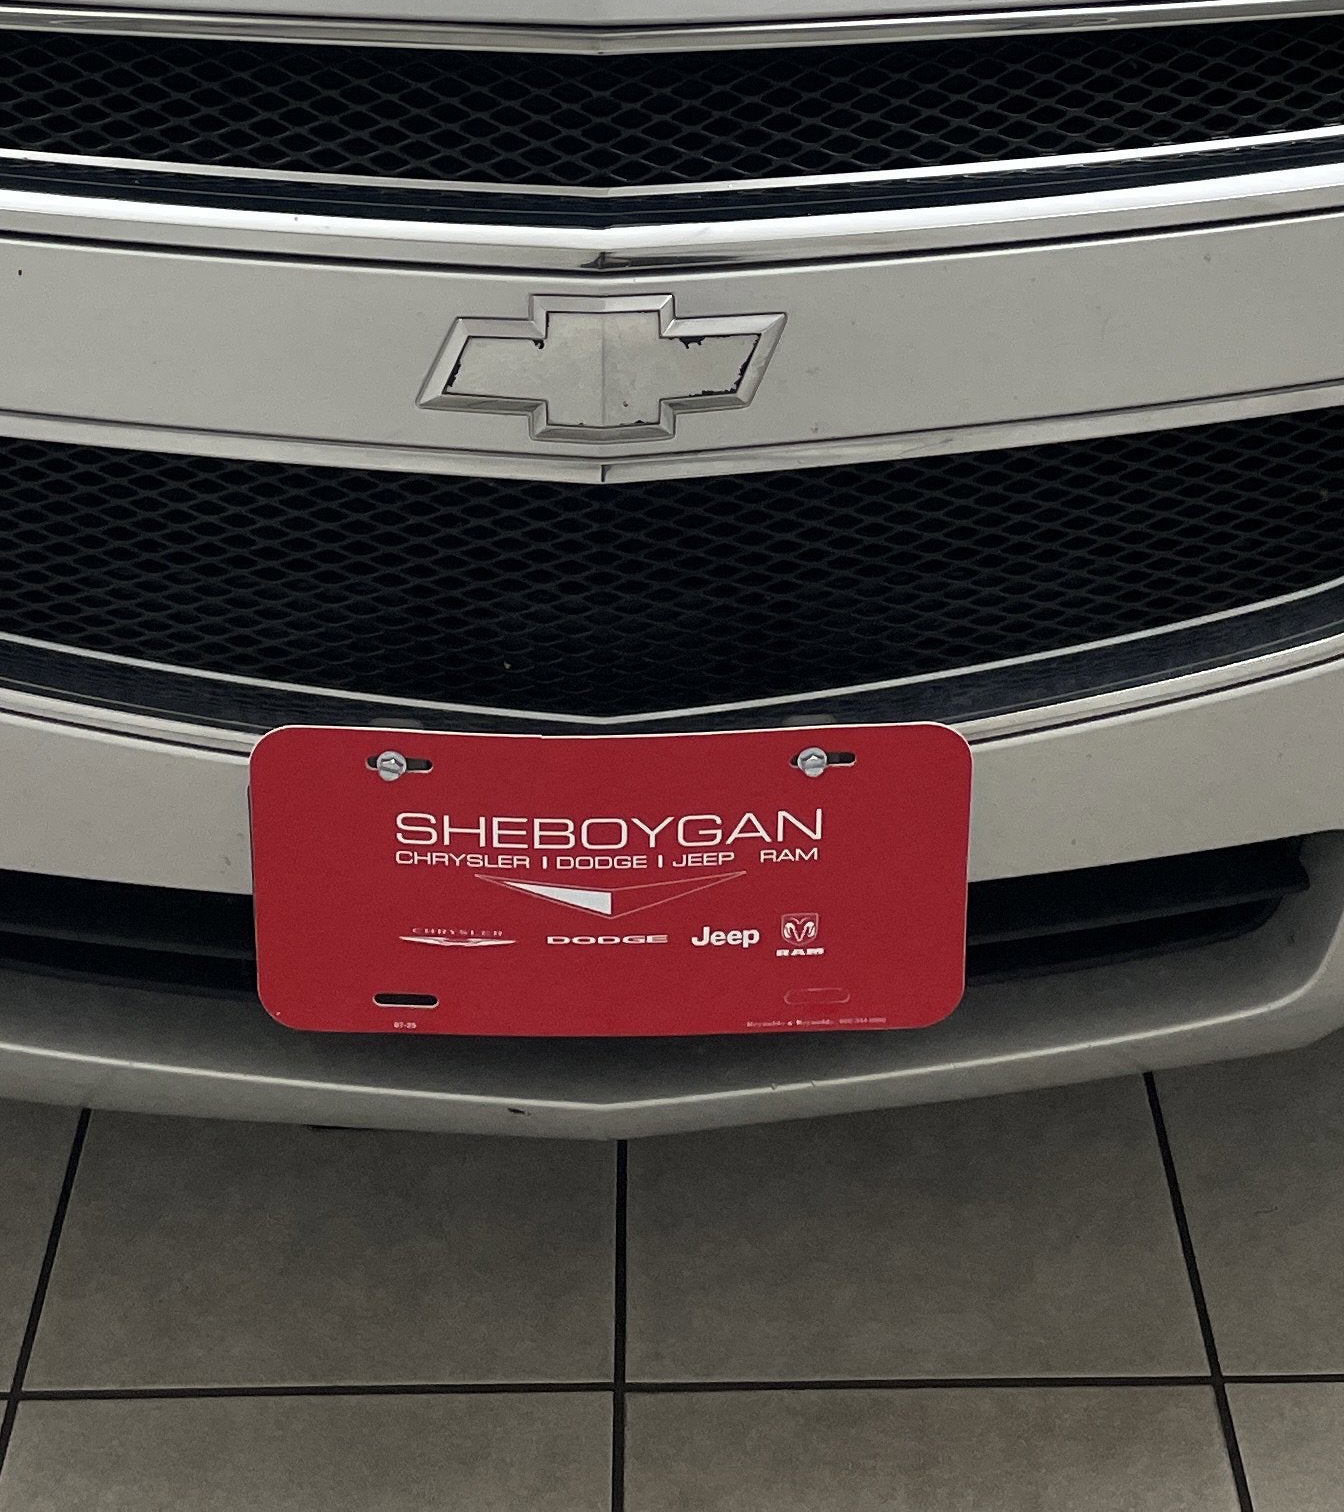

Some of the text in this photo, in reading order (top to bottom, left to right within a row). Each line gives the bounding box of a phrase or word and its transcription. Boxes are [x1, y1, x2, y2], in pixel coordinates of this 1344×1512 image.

[396, 808, 822, 850] SHEBOYGAN
[395, 850, 530, 869] CHRYSLER
[556, 855, 648, 870] DODGE
[672, 851, 735, 868] JEEP
[760, 847, 819, 863] RAM
[547, 934, 668, 945] DODGE
[691, 926, 760, 948] Jeep
[776, 947, 825, 957] RAM
